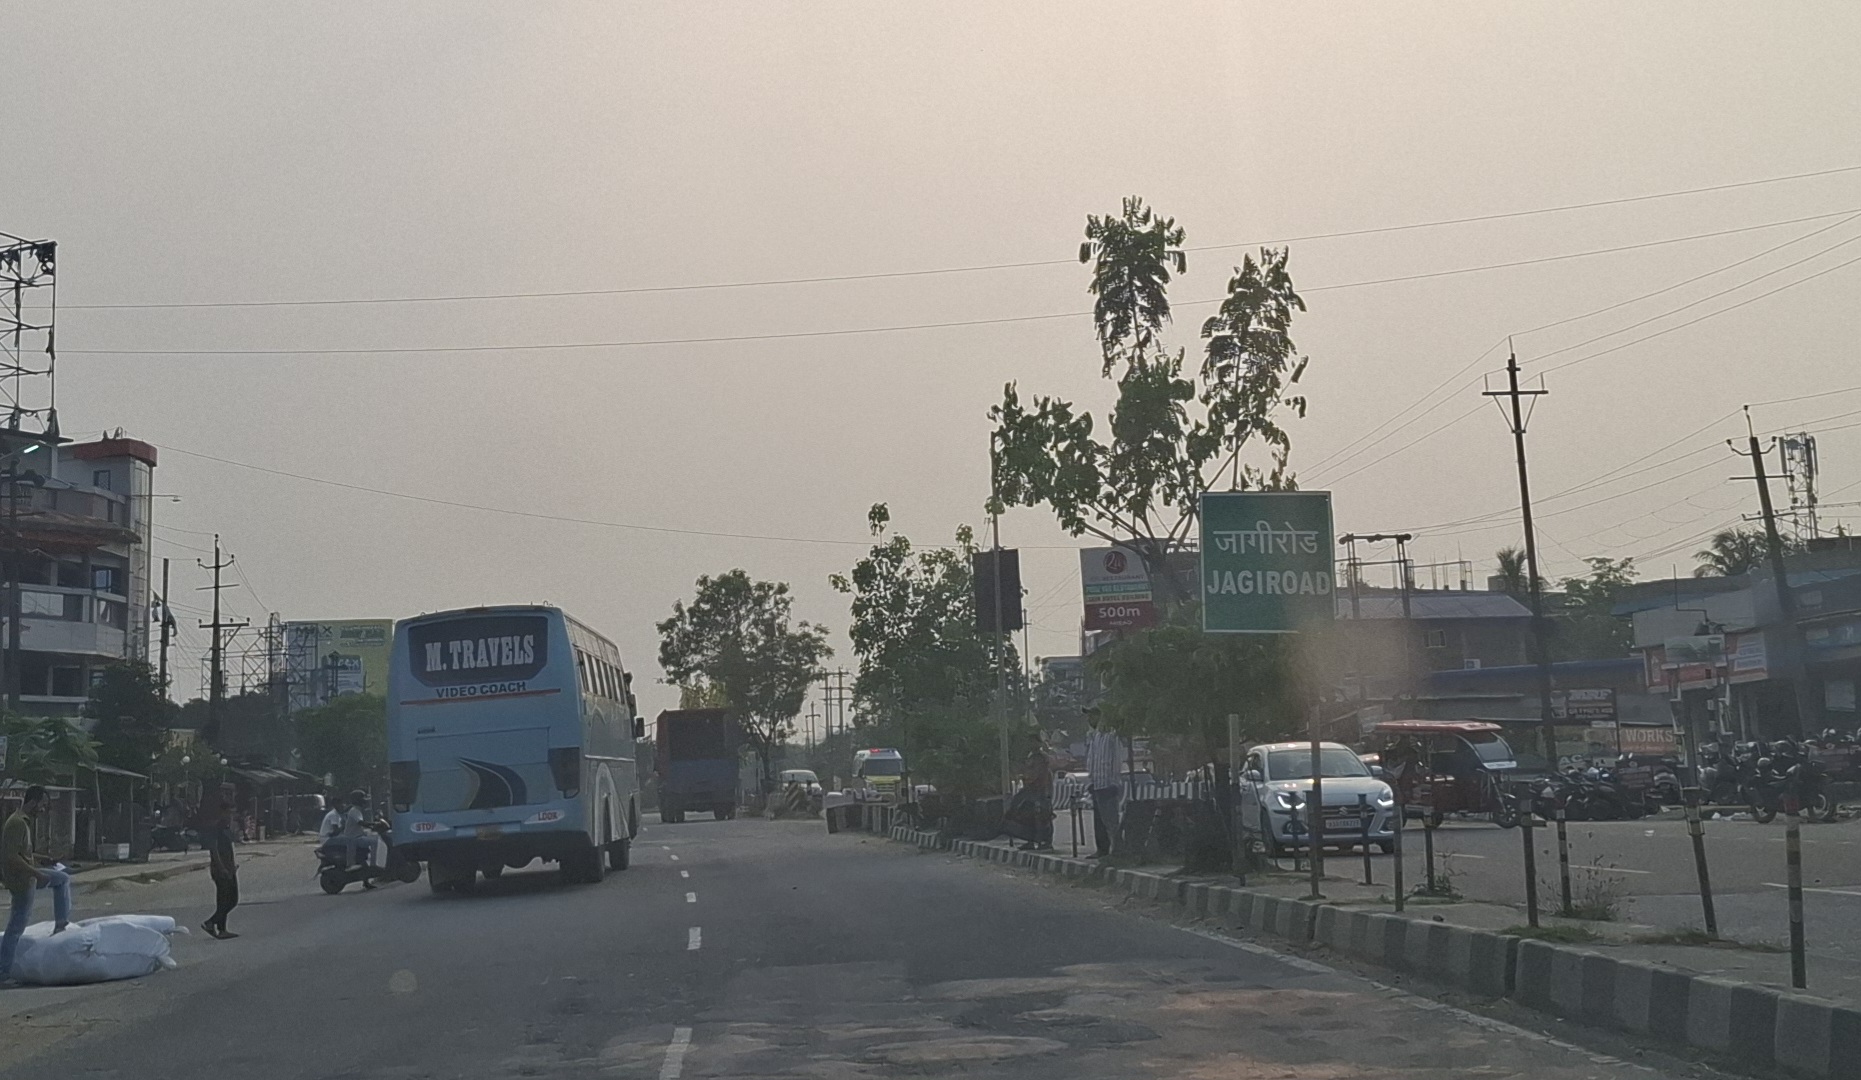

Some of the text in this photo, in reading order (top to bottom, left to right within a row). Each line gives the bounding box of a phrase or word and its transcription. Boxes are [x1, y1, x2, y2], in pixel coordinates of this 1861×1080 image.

[1212, 520, 1319, 554] जागीरोड
[1207, 570, 1331, 595] JAGIROAD
[1099, 606, 1141, 618] 500m
[436, 681, 527, 698] VIDEO COACH
[1625, 728, 1673, 743] WORKS
[538, 811, 558, 821] LOOK
[415, 821, 436, 831] STOP
